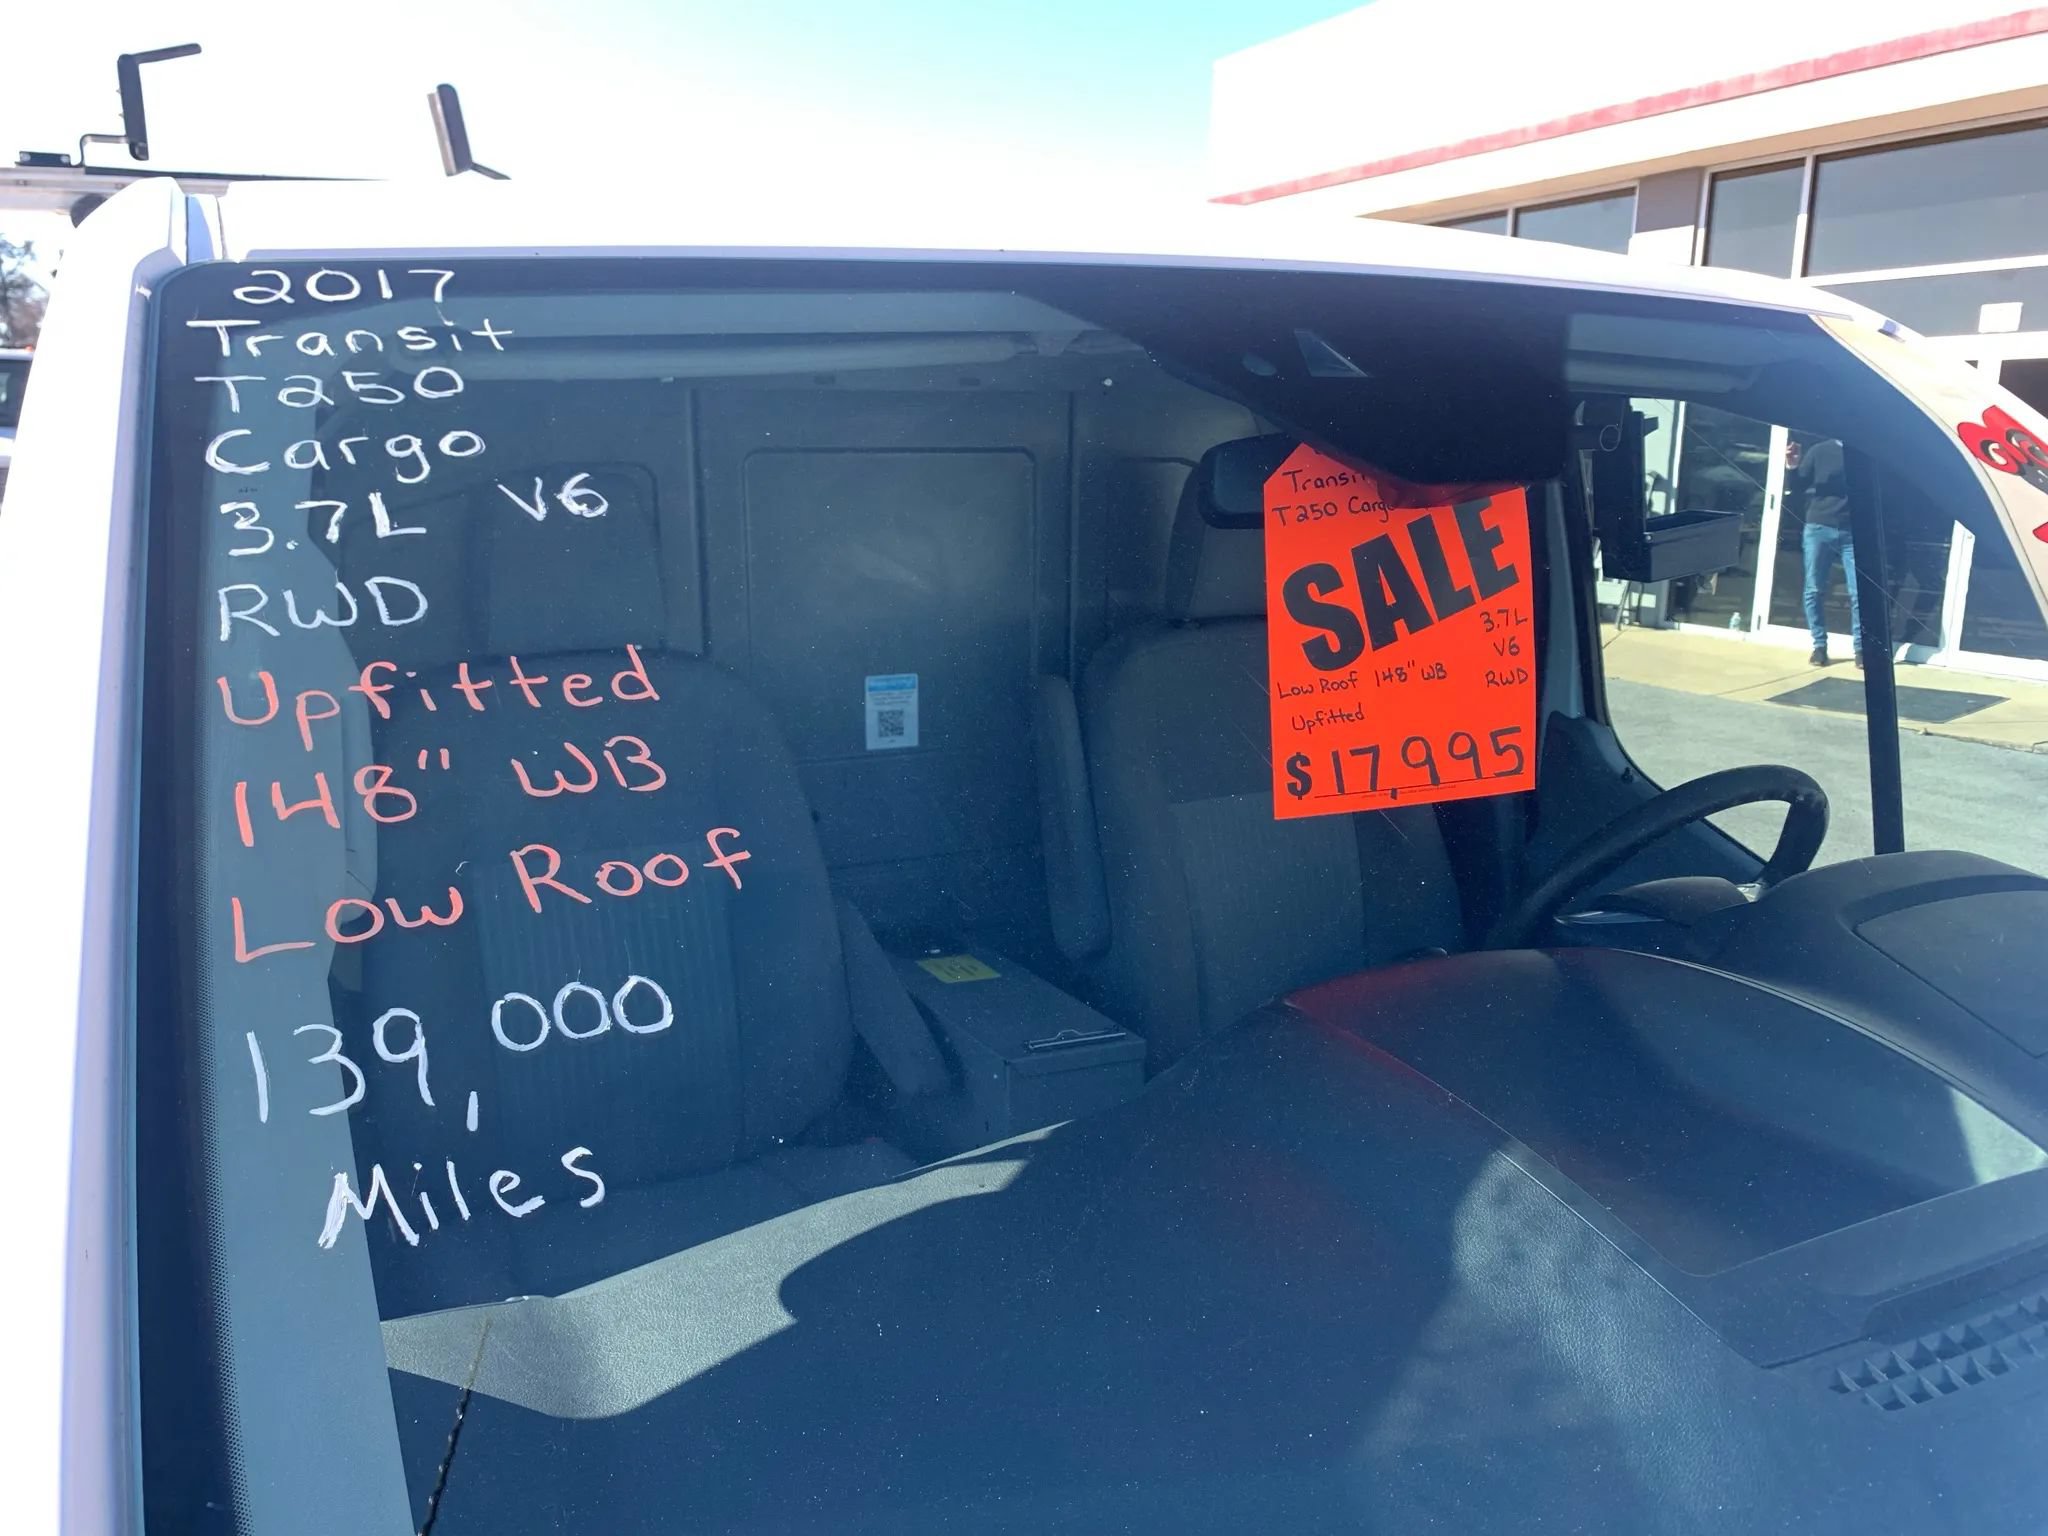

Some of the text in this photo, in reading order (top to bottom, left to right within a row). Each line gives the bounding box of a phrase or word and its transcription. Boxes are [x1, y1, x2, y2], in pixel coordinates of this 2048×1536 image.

[234, 269, 455, 303] 2017
[186, 319, 513, 357] Transit
[194, 367, 464, 413] T250
[205, 429, 486, 484] Cargo
[220, 473, 609, 556] 3.7L V6
[1271, 502, 1338, 527] T250
[1282, 496, 1520, 672] SALE
[219, 576, 428, 641] RWD
[1479, 607, 1529, 633] 3.7L
[1493, 637, 1521, 657] V6
[217, 643, 661, 751] Upfitted
[1277, 660, 1448, 699] Low Roof 148" WB
[1485, 668, 1529, 687] RWD
[1292, 702, 1366, 734] Upfitted
[234, 736, 667, 847] 148" WB
[232, 828, 751, 963] Low Roof
[317, 1147, 606, 1249] Miles
